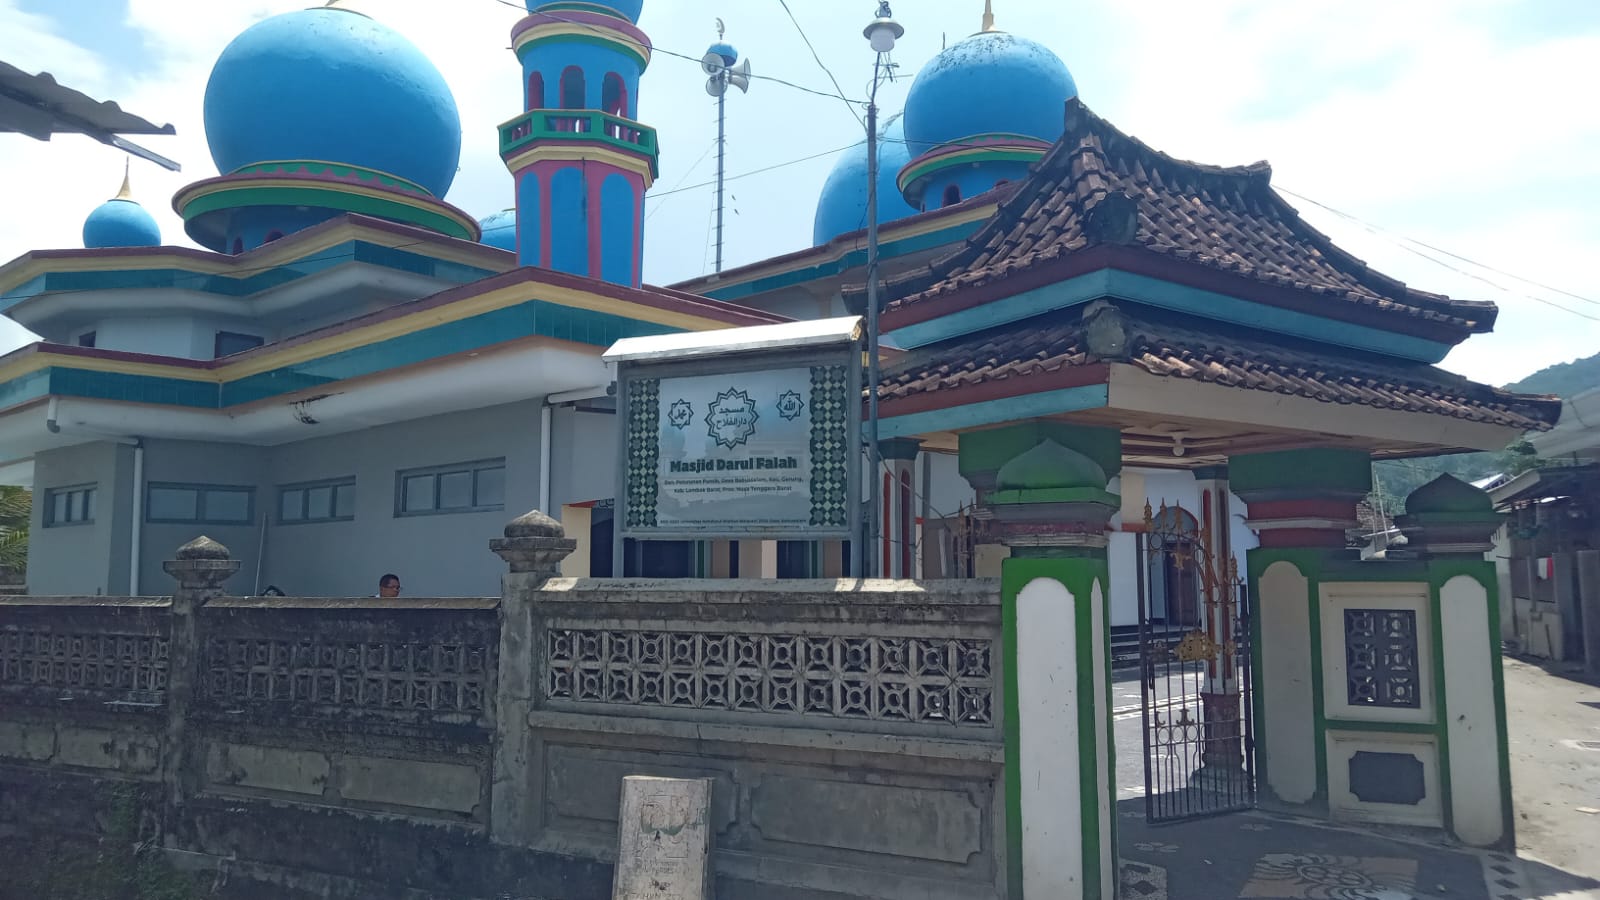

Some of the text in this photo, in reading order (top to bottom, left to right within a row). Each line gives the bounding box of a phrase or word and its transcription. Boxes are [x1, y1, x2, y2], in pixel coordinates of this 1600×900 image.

[718, 407, 745, 416] مسجد
[670, 456, 797, 473] Masjid Darul Falah
